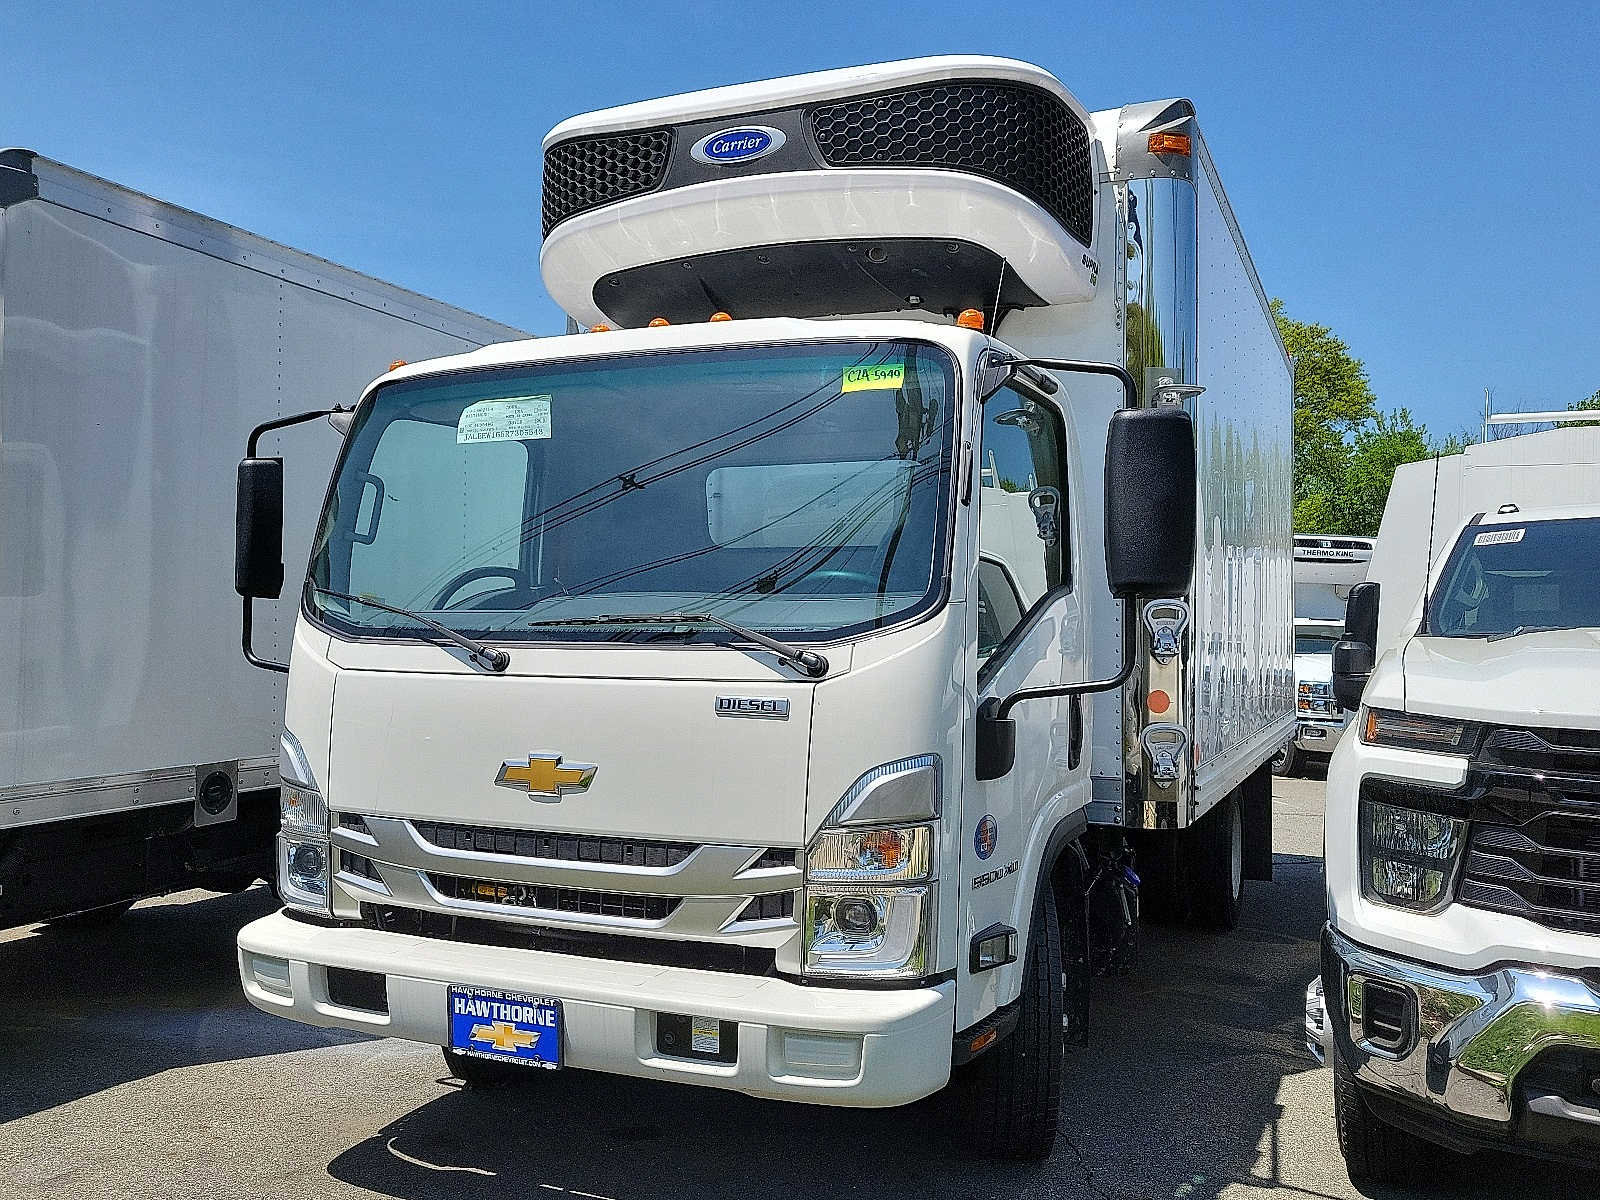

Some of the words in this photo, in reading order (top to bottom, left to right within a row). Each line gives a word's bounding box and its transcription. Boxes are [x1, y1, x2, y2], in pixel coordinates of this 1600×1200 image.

[712, 136, 763, 154] Carrier
[1303, 549, 1335, 557] THERMO
[719, 698, 783, 712] DIESEL
[451, 985, 503, 999] HAWTHORNE
[505, 993, 555, 1007] CHEVROLET
[454, 997, 556, 1027] HAWTHORNE
